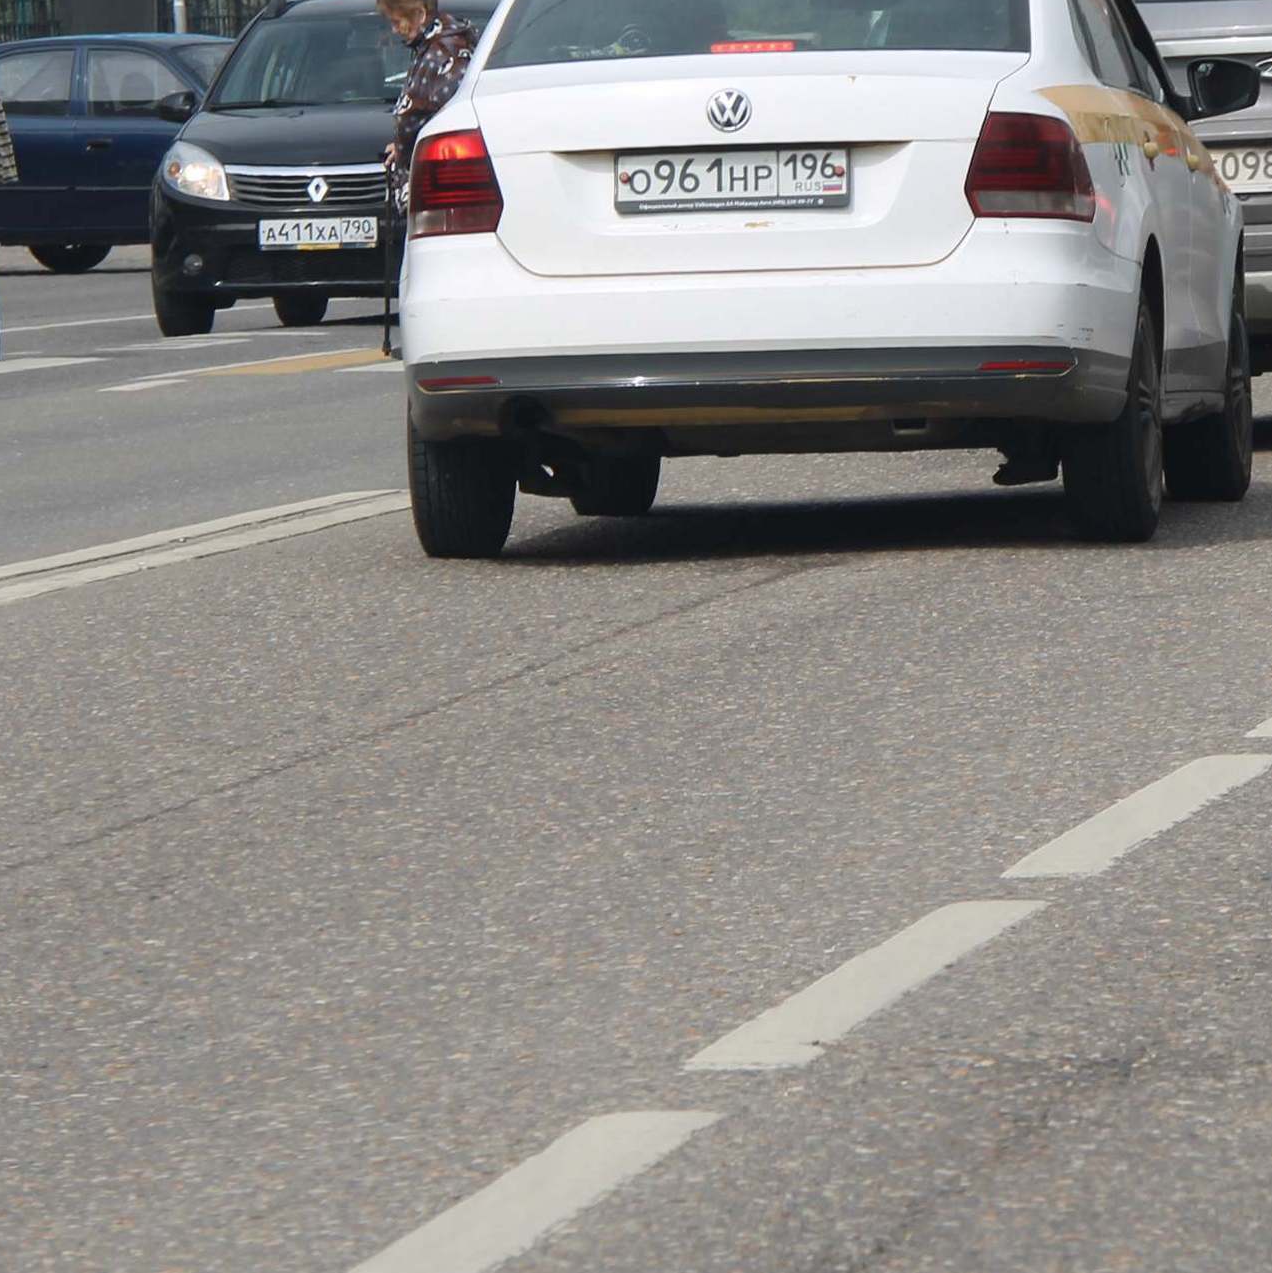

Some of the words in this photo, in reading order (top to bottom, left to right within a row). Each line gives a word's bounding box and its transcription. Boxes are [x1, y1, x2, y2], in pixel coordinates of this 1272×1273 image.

[629, 157, 773, 195] О961НР
[783, 151, 837, 181] 196
[794, 181, 822, 192] RUS
[266, 221, 339, 241] А411ХА
[343, 219, 371, 234] 790
